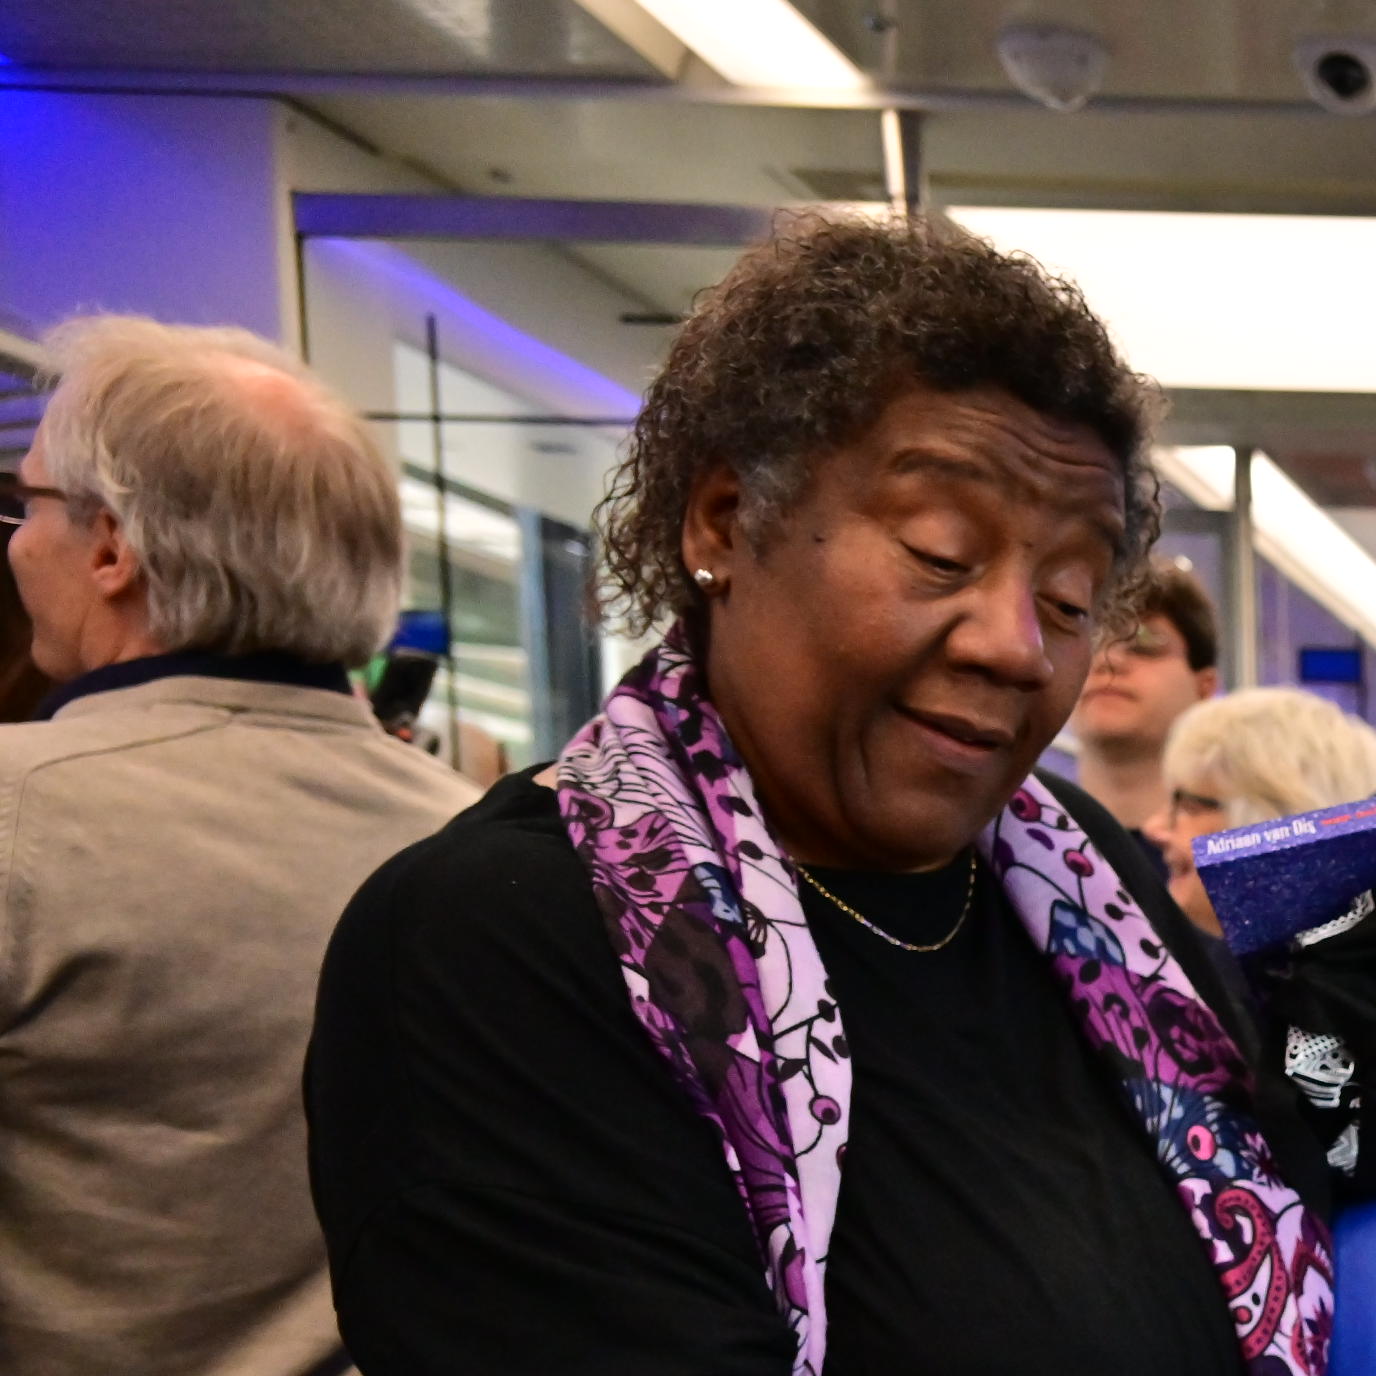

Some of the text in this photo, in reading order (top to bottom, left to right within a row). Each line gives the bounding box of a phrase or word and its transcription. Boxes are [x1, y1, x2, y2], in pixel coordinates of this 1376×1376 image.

[1207, 819, 1317, 855] Adriaan van Dis
